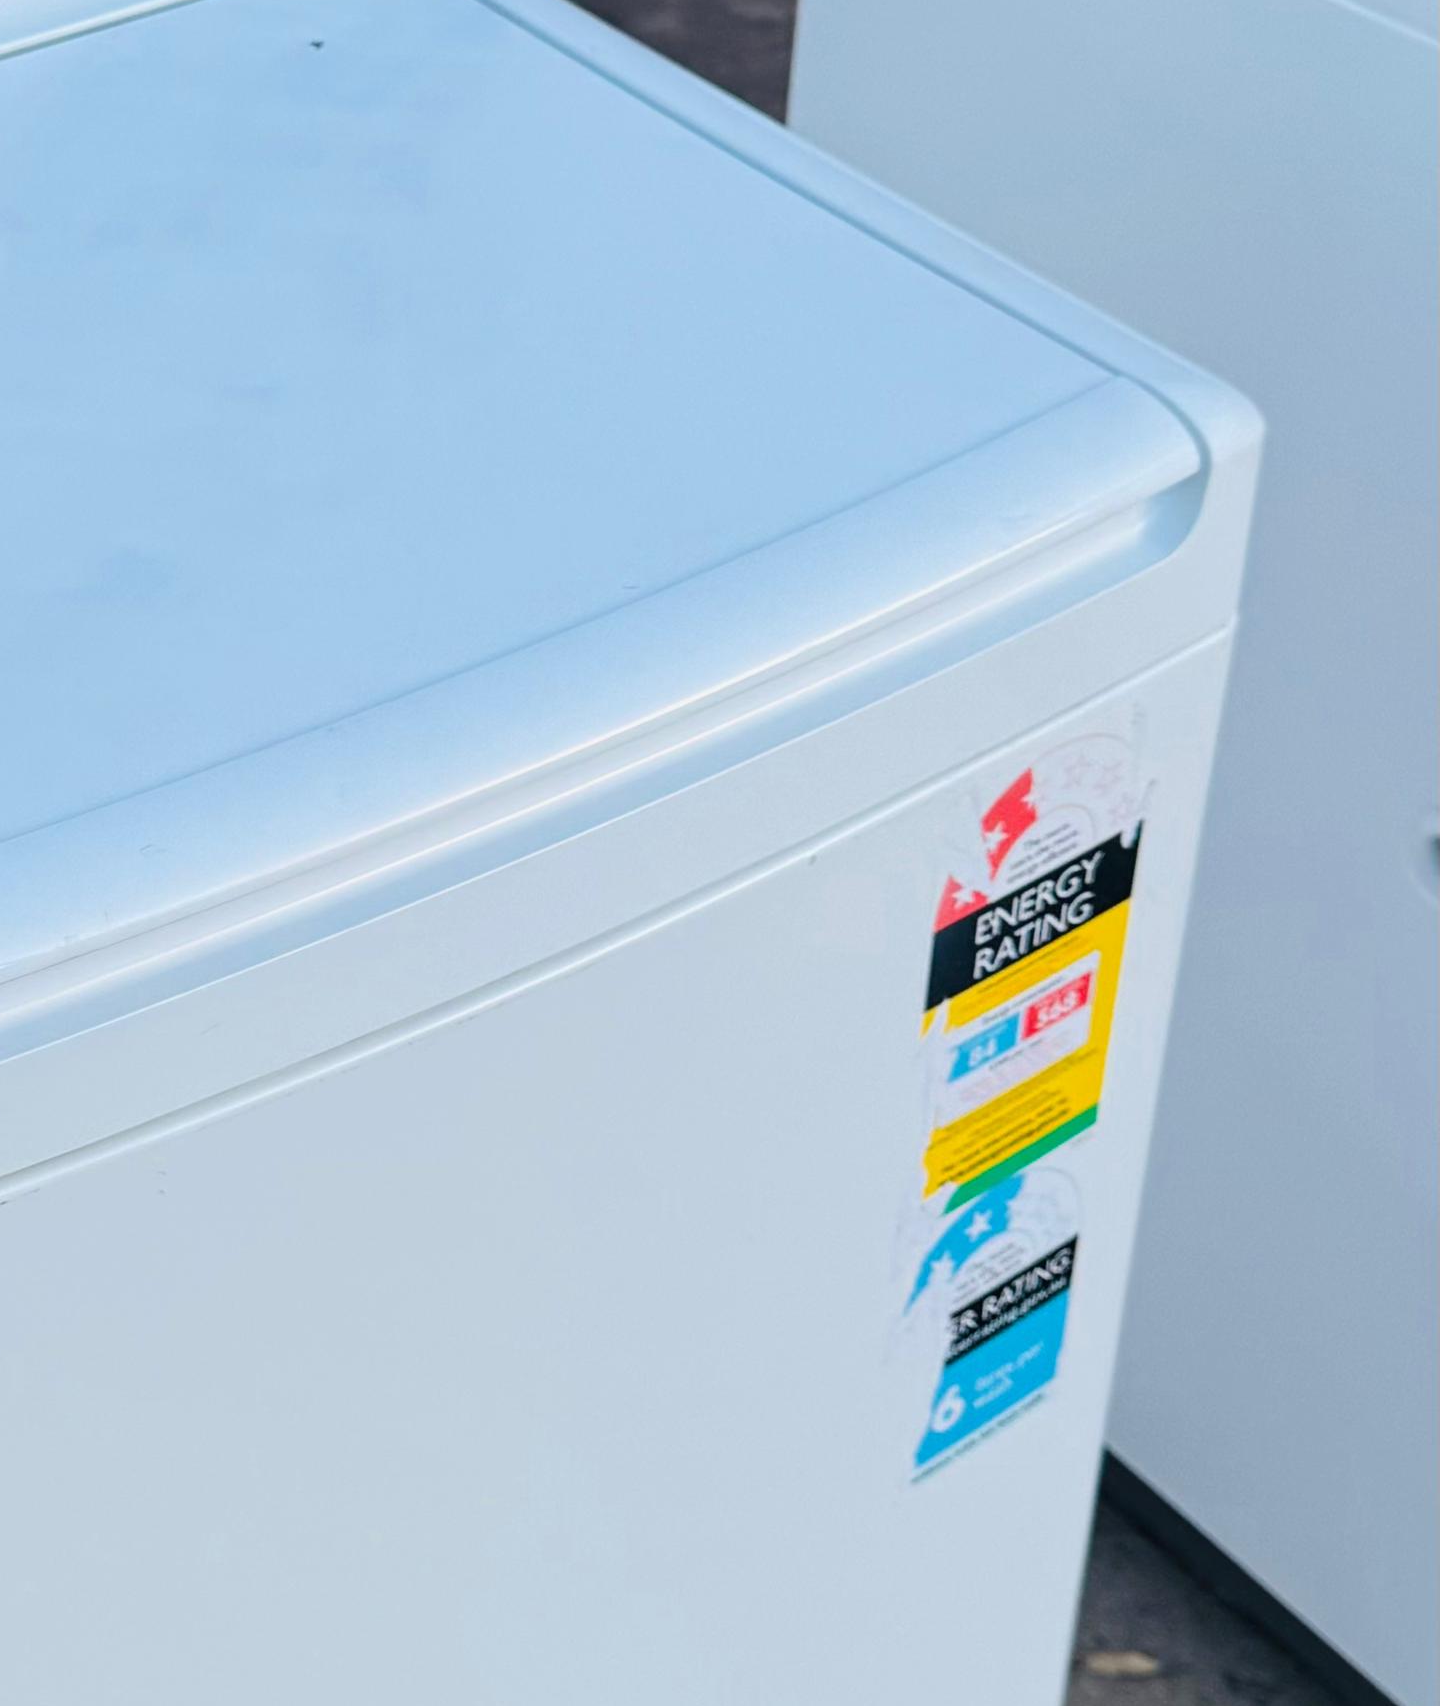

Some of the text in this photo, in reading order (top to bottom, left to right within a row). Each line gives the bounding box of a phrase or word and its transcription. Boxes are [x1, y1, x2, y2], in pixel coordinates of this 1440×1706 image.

[973, 891, 1096, 980] RATING
[975, 850, 1105, 946] ENERGY
[980, 1247, 1073, 1323] RATING
